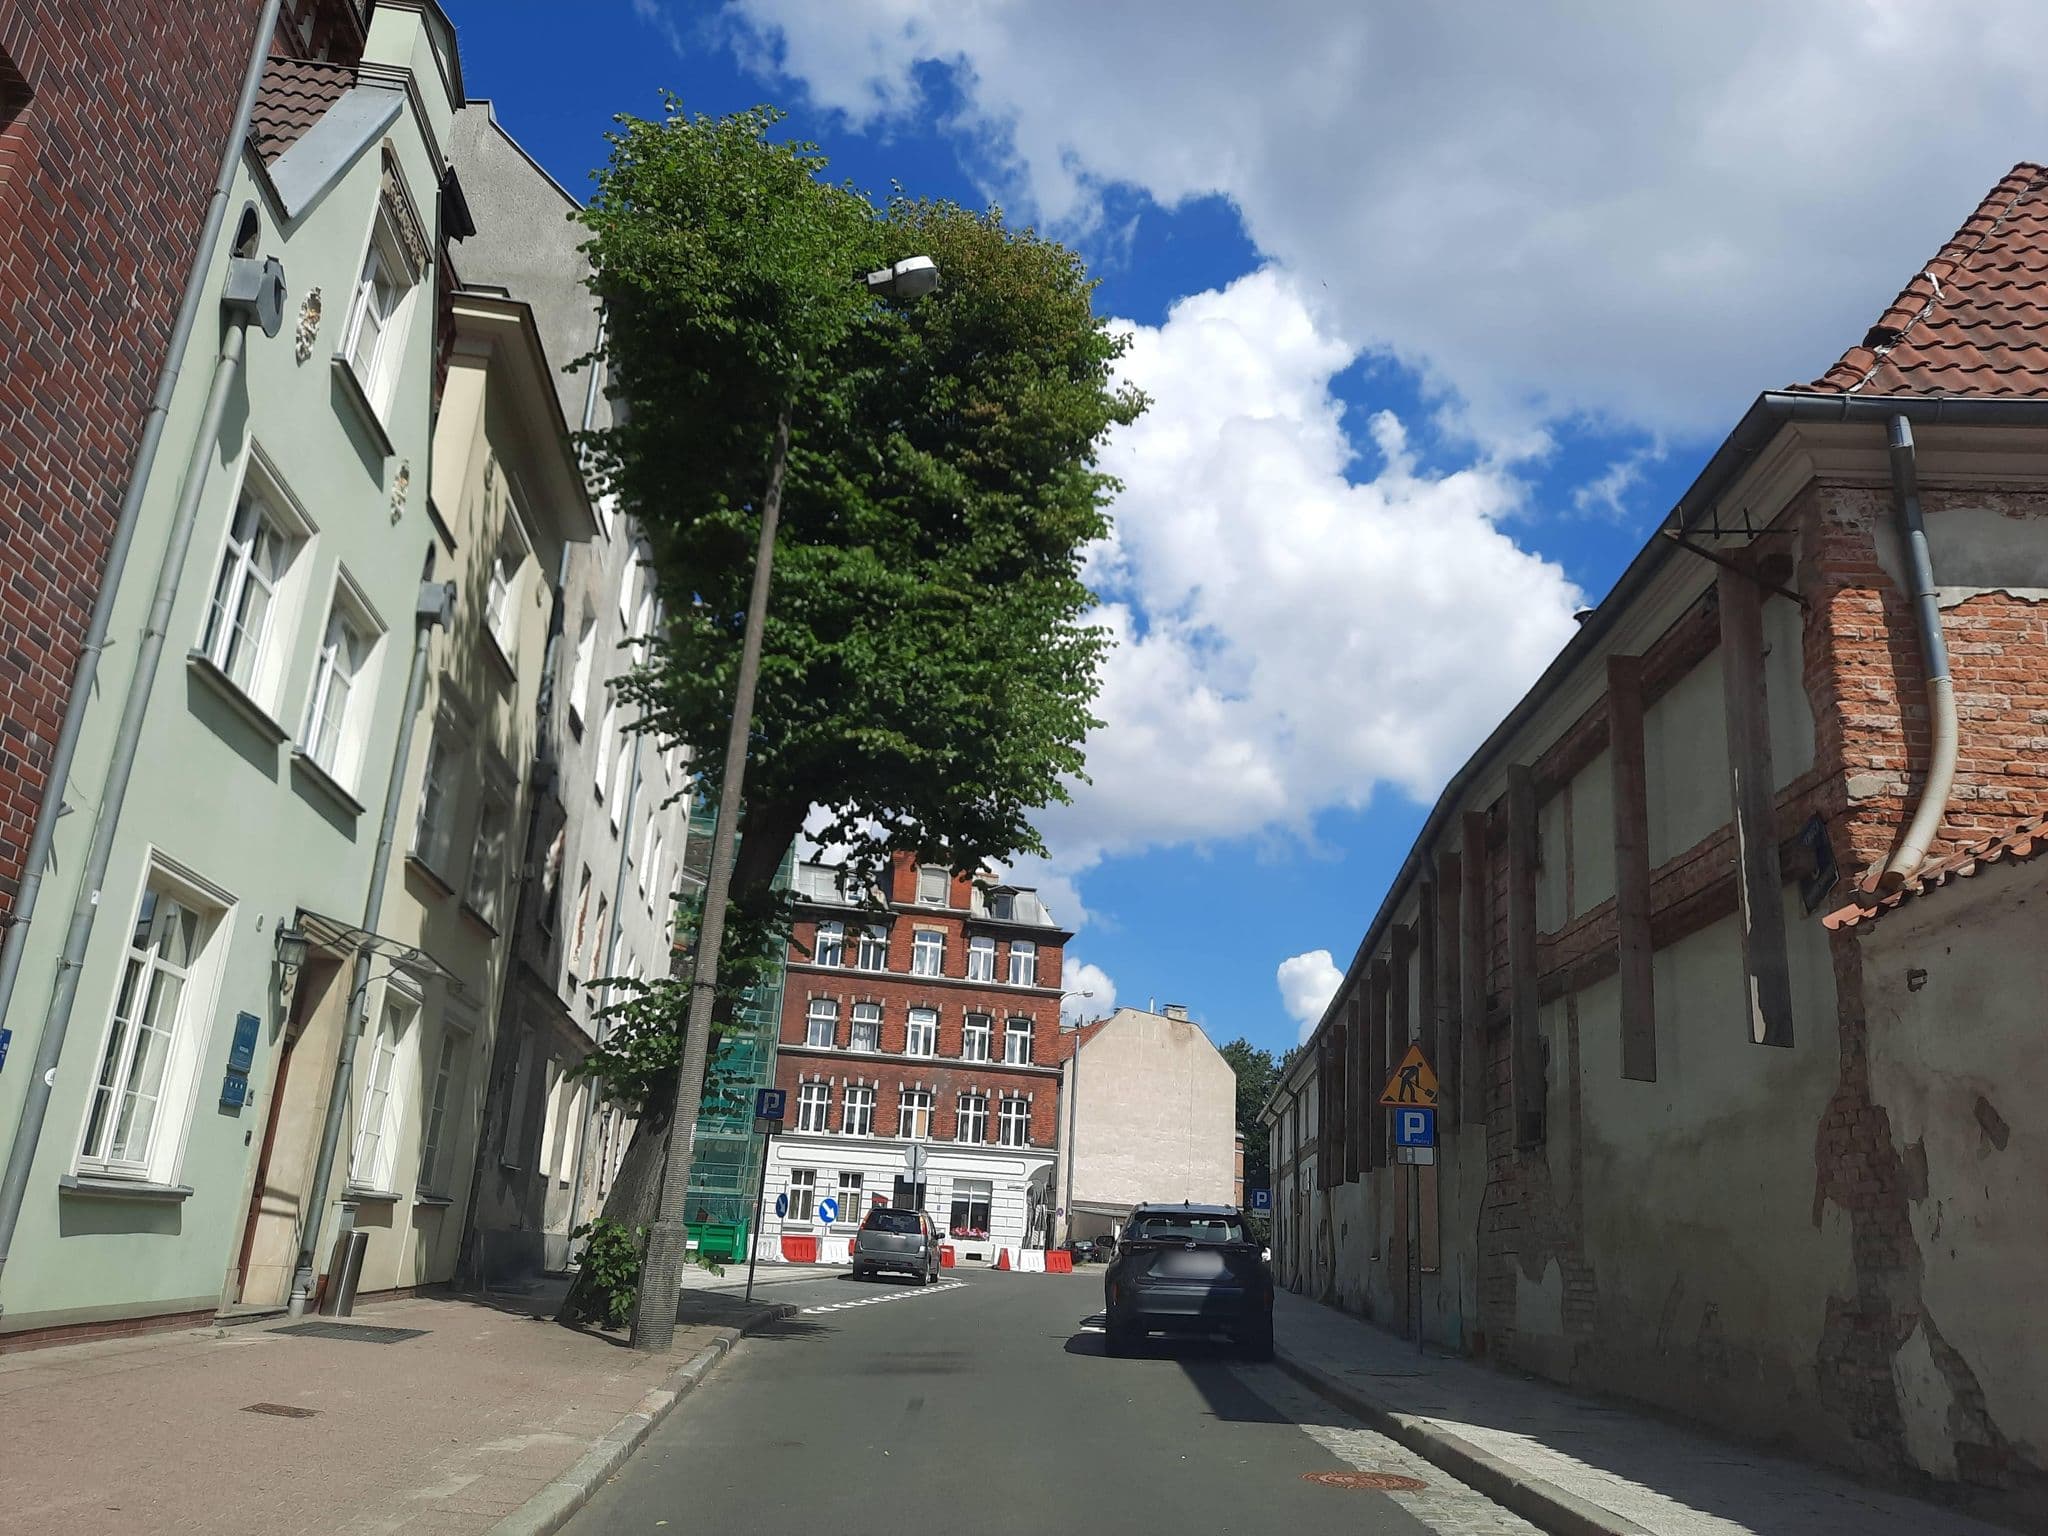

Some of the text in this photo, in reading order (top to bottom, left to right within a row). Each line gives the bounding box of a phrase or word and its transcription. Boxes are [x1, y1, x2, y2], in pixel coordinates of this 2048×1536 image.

[763, 1092, 780, 1114] P
[1404, 1112, 1425, 1142] P
[1256, 1191, 1268, 1207] P
